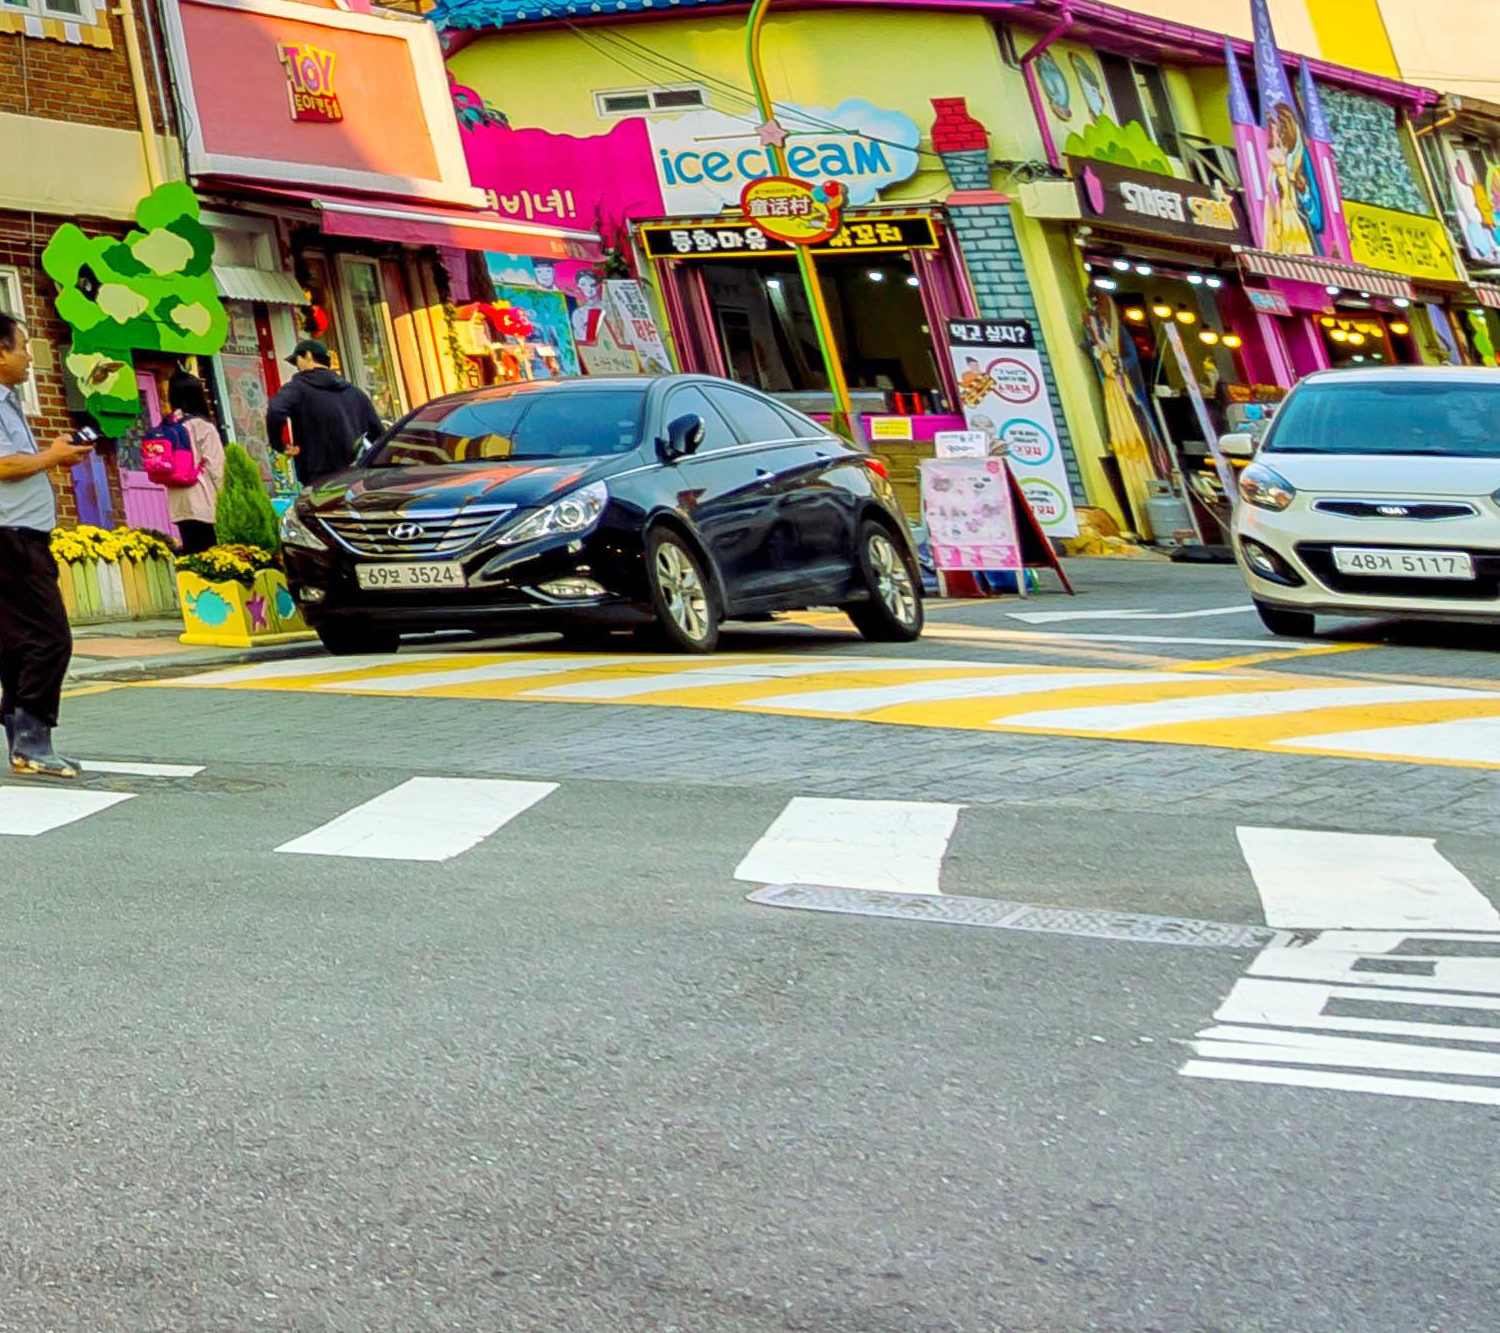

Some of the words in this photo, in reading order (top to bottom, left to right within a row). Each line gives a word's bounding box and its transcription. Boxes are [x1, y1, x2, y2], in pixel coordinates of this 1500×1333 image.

[279, 42, 336, 96] TOY
[659, 148, 731, 185] ice
[749, 196, 811, 217] 童话村
[1119, 181, 1186, 223] STREET
[670, 227, 767, 253] 동화마을
[950, 324, 984, 341] 먹고
[368, 568, 402, 585] 69보
[407, 566, 454, 584] 3524
[1401, 555, 1456, 574] 5117
